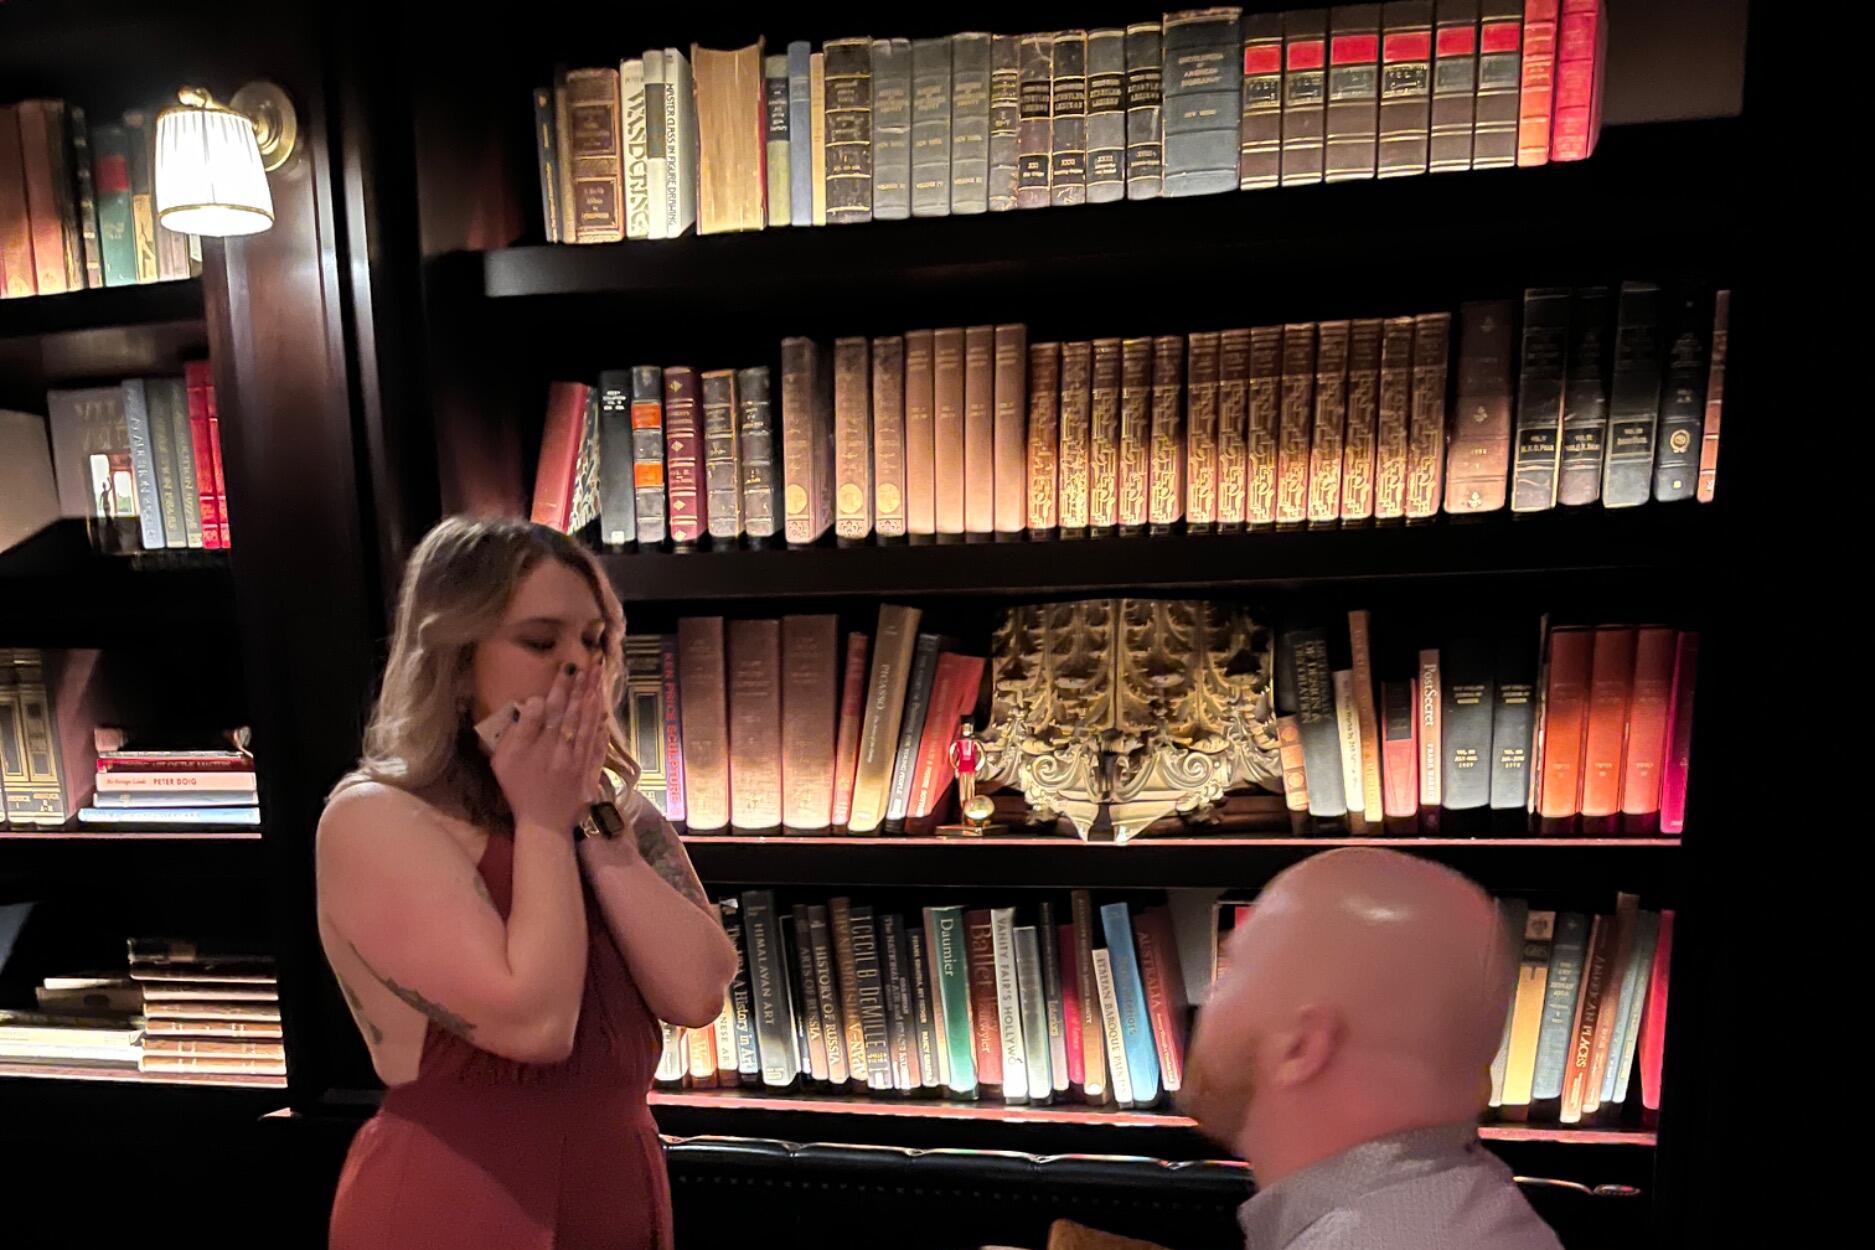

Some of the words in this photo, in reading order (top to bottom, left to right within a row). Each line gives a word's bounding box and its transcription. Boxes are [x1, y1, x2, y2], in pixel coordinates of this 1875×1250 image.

[665, 83, 676, 117] MASTER
[665, 118, 676, 143] CLASS
[666, 145, 677, 154] IN
[666, 156, 678, 186] FIGURE
[664, 682, 676, 720] PRICE
[875, 664, 891, 710] PICASSO
[1423, 664, 1439, 726] PostSecret
[153, 778, 174, 786] PETER
[176, 778, 197, 786] DOIG
[666, 725, 681, 801] SCULPTURE
[852, 925, 877, 963] CECIL
[886, 935, 899, 980] NATIONAL
[939, 918, 957, 976] Daumier
[970, 924, 997, 986] Ballet
[997, 918, 1010, 959] VANITY
[754, 923, 772, 997] HIMALAYAN
[763, 1001, 775, 1025] ART
[815, 945, 833, 999] HISTORY
[1000, 964, 1012, 1001] FAIR'S
[1138, 932, 1161, 997] AUSTRALIA
[734, 991, 751, 1032] History
[806, 998, 821, 1040] RUSSIA
[823, 1003, 836, 1020] OF
[859, 986, 886, 1048] DeMILLE
[1096, 958, 1111, 999] ITALIAN
[1104, 1003, 1121, 1052] BAROQUE
[740, 1035, 753, 1046] in
[742, 1048, 757, 1067] Art
[825, 1023, 841, 1064] RUSSIA
[1575, 1024, 1592, 1068] PLACES
